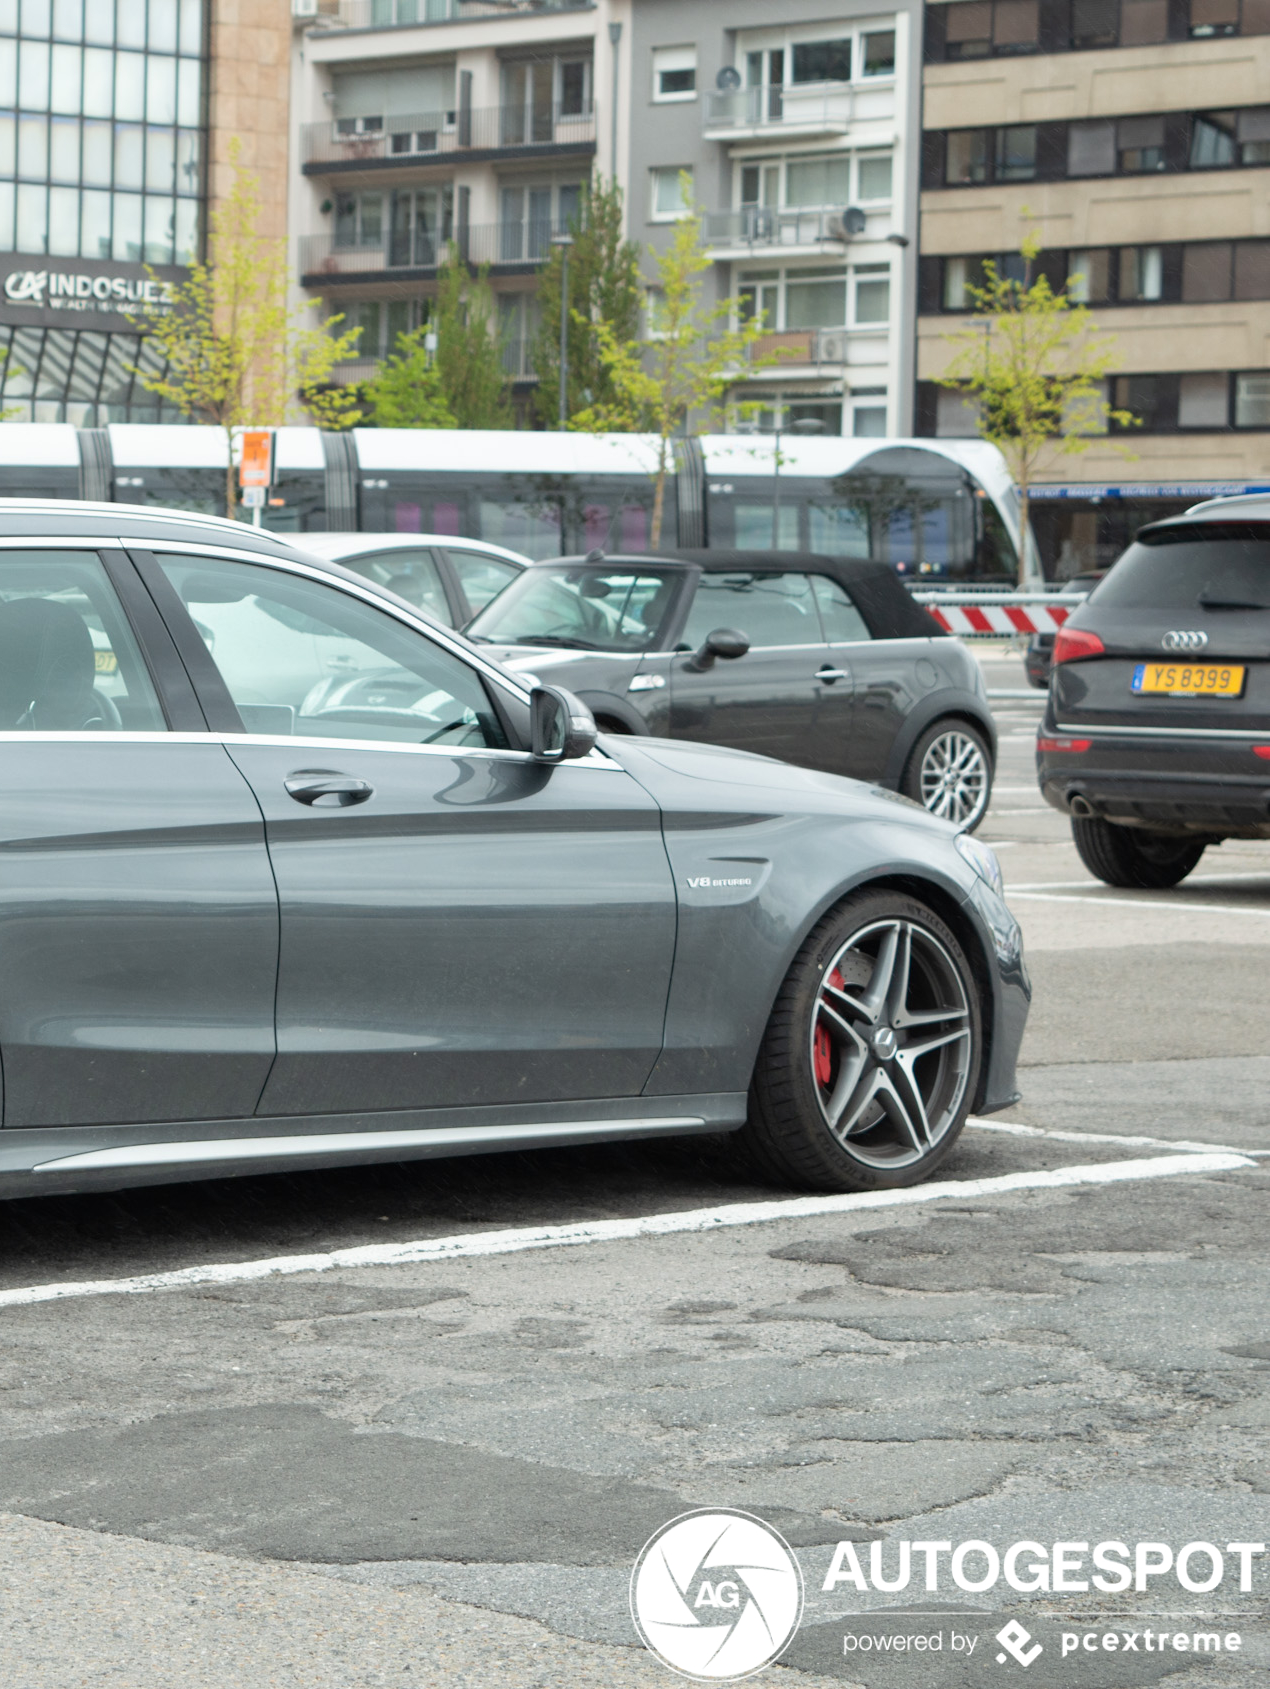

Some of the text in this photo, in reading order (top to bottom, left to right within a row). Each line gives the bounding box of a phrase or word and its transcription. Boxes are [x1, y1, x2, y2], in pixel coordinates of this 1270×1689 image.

[49, 273, 173, 304] INDOSUEZ
[1154, 668, 1231, 689] YS 8399
[687, 877, 752, 888] V8 BITURBO
